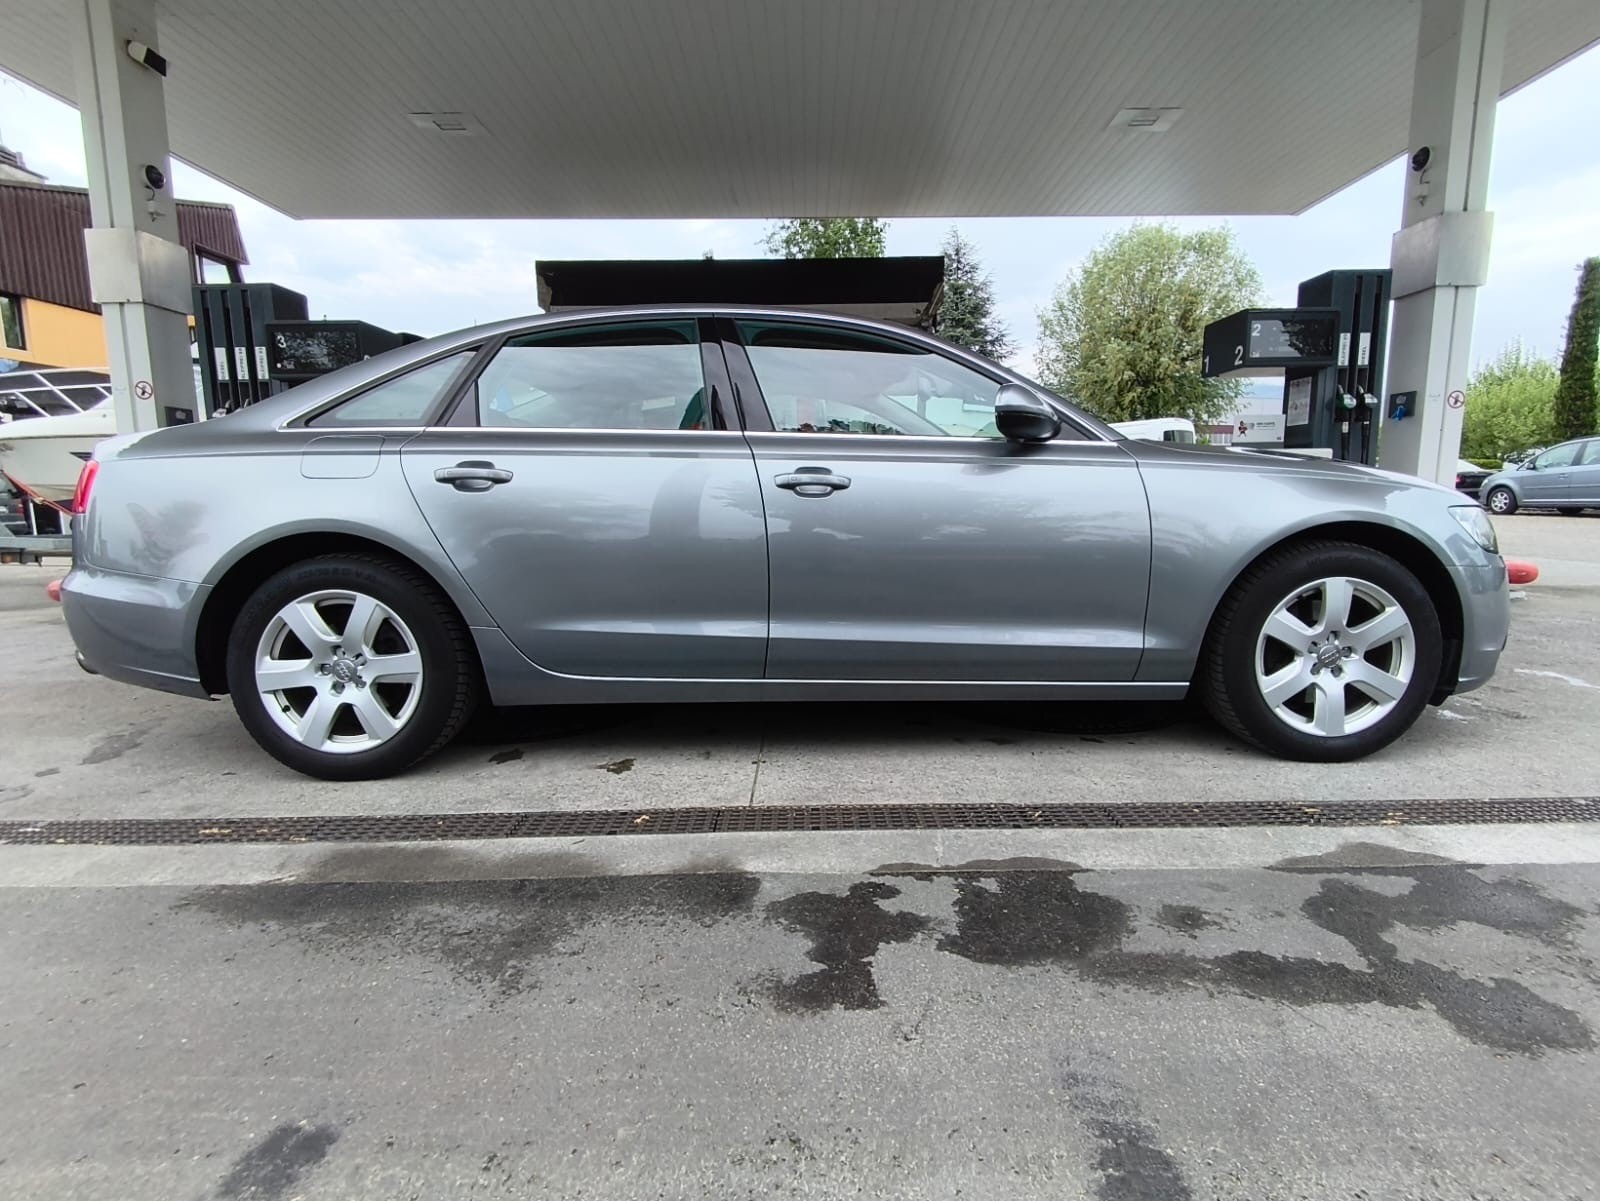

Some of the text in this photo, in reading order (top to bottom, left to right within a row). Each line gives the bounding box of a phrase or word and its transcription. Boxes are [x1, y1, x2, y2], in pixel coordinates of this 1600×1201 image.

[1251, 323, 1262, 337] 2
[277, 335, 287, 348] 3
[1234, 345, 1244, 366] 2
[1204, 355, 1210, 374] 1
